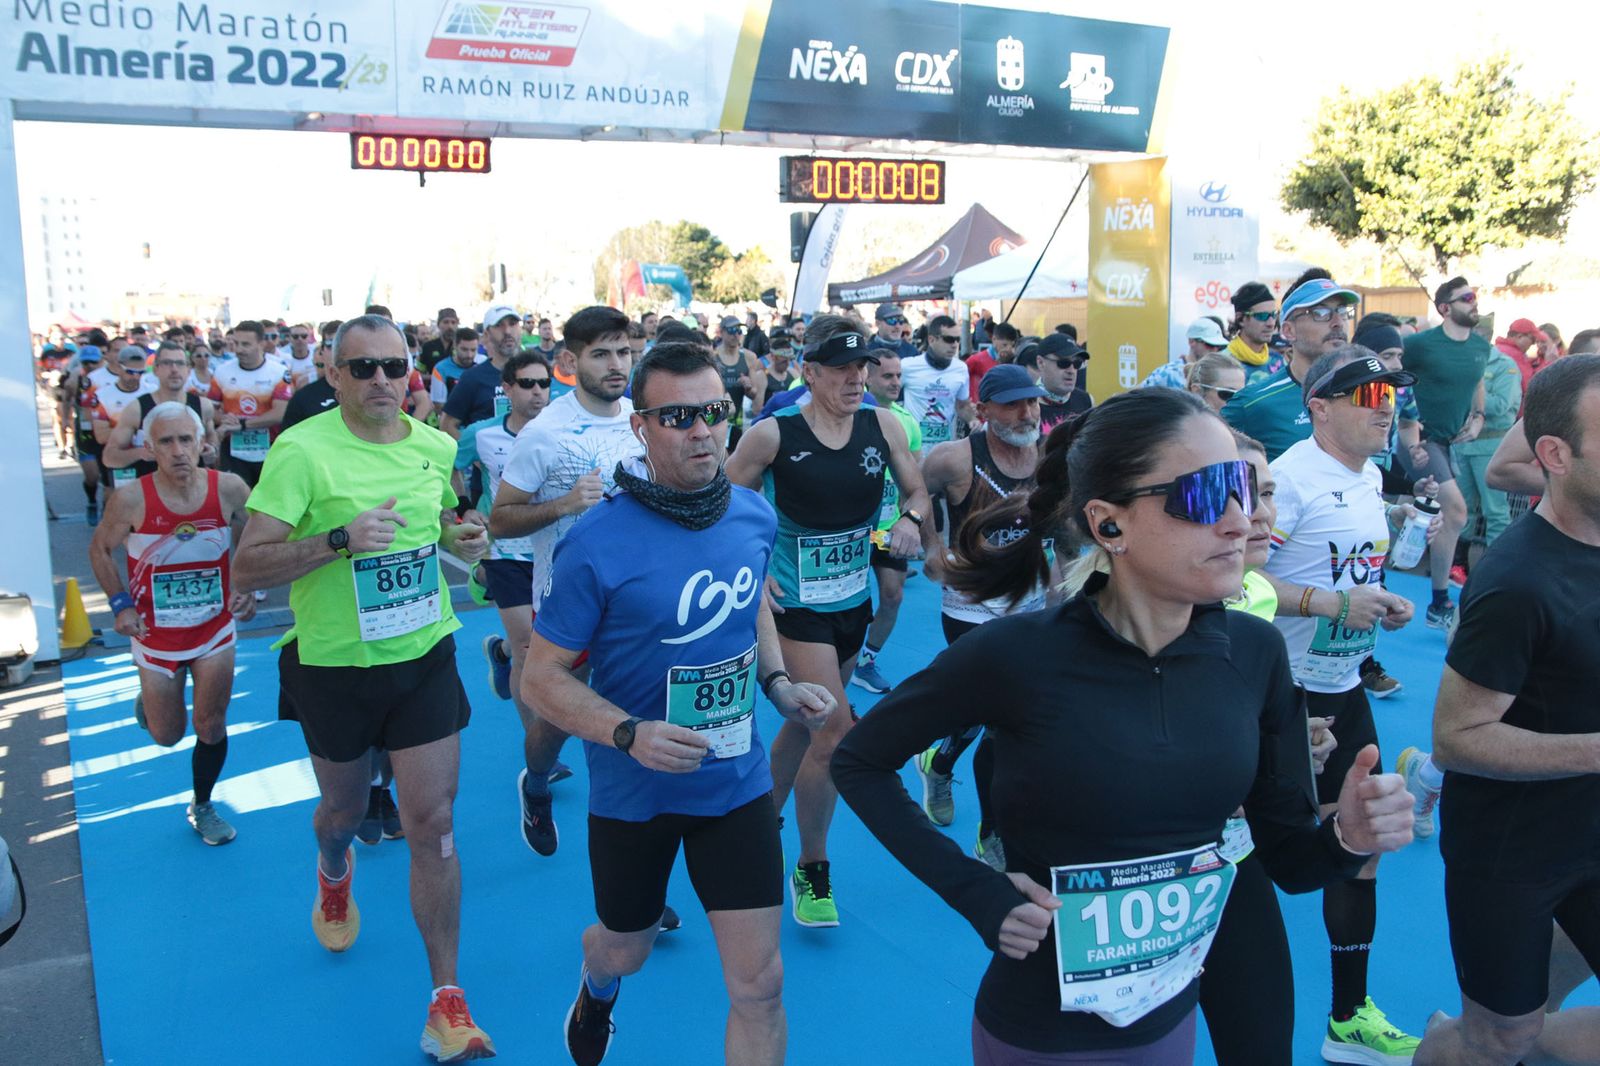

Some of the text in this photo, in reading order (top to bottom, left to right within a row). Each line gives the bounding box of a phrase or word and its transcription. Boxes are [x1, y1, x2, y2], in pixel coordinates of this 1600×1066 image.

[14, 0, 348, 44] Medio Maratón
[16, 31, 215, 82] Almería
[459, 44, 551, 62] Prueba Oficial
[789, 46, 868, 85] NEXA
[895, 49, 959, 86] CDX
[422, 75, 690, 107] RAMÓN RUIZ ANDÚJAR
[986, 94, 1035, 110] ALMERÍA
[813, 160, 940, 200] 00:00:08
[1104, 198, 1154, 232] NEXA
[1187, 206, 1243, 218] HYUNDAI
[1193, 253, 1236, 261] ESTRELLA
[1105, 267, 1151, 300] CDX
[1195, 280, 1231, 308] ego
[926, 427, 947, 438] 249
[809, 540, 865, 568] 1484
[162, 579, 215, 598] 1437
[376, 561, 426, 593] 867
[388, 587, 420, 600] ANTONIO
[694, 670, 750, 712] 897
[706, 705, 742, 720] MANUEL
[1111, 860, 1176, 877] Medio Maratón
[1112, 874, 1150, 887] Almería
[1081, 874, 1222, 946] 1092
[1087, 943, 1137, 963] FARAH
[1141, 932, 1183, 953] RIOLA
